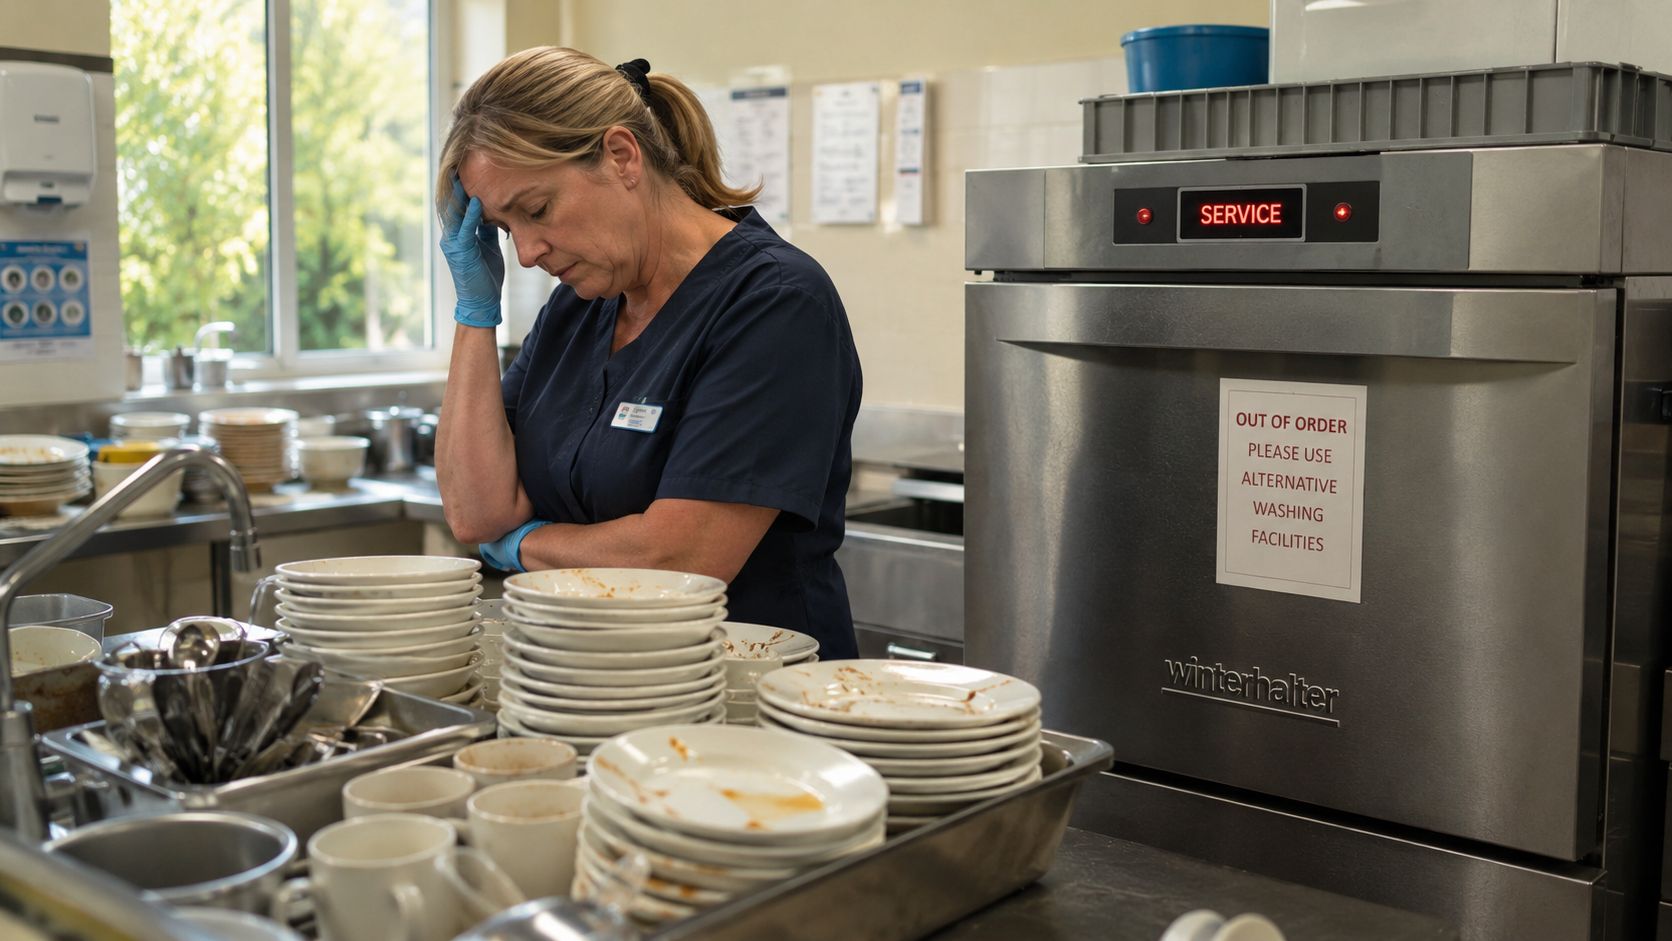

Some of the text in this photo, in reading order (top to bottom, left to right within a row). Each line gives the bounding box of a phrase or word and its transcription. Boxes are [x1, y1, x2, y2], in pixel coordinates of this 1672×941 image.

[1200, 203, 1282, 224] SERVICE
[1236, 412, 1347, 434] OUT OF ORDER
[1248, 442, 1332, 464] PLEASE USE
[1241, 471, 1337, 494] ALTERNATIVE
[1253, 500, 1324, 522] WASHING
[1251, 529, 1324, 552] FACILITIES
[1164, 655, 1340, 714] winterhalter
